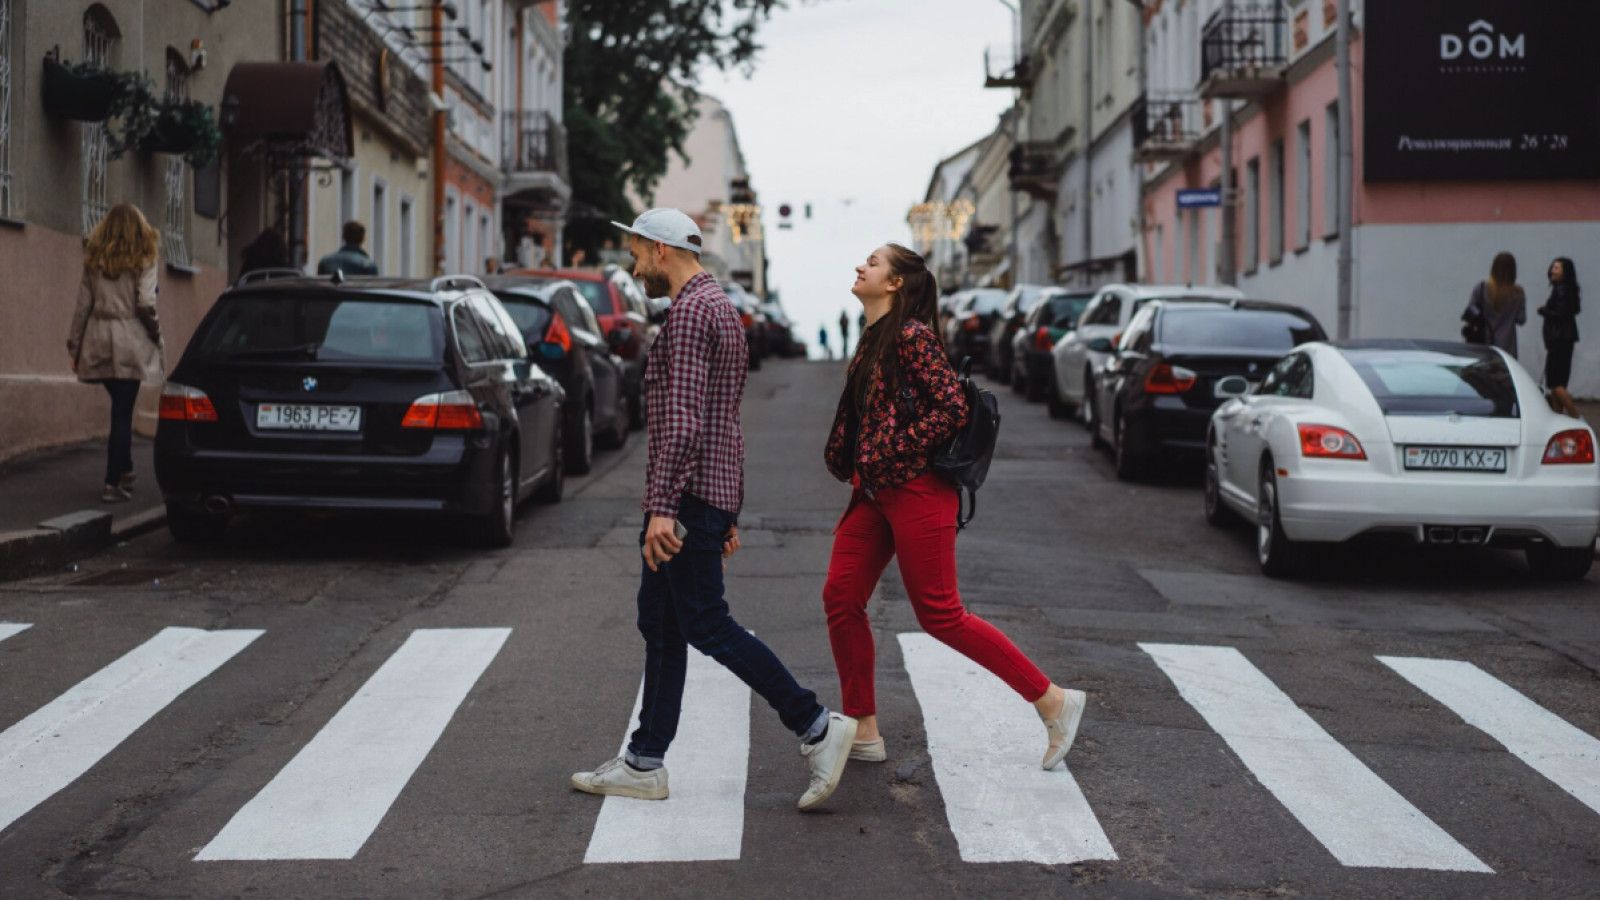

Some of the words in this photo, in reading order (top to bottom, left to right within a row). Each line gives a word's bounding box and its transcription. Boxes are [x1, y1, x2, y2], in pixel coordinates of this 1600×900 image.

[276, 406, 312, 423] 1963
[317, 407, 358, 425] PE-7
[1421, 449, 1458, 466] 7070
[1464, 449, 1502, 468] KX-7
